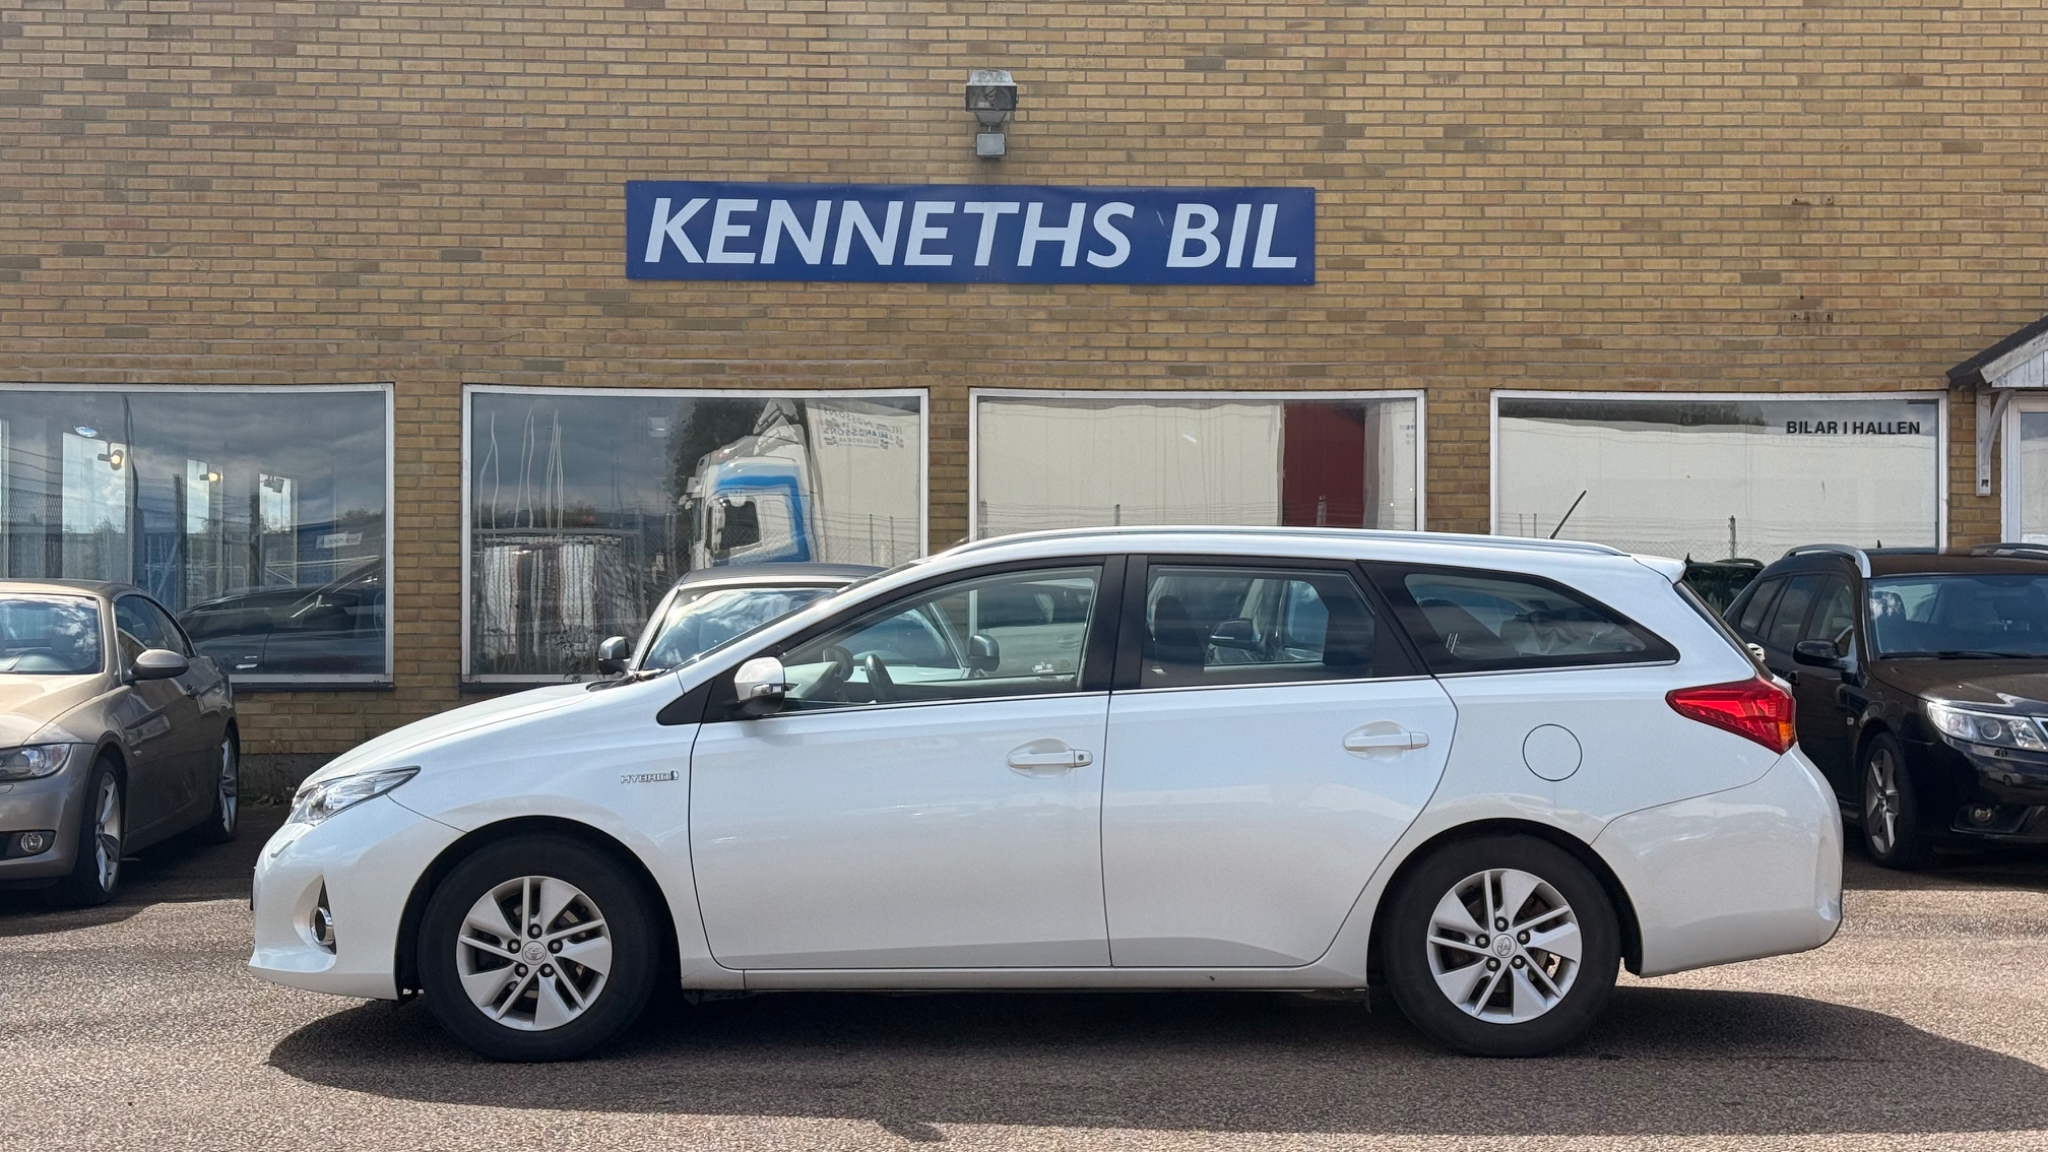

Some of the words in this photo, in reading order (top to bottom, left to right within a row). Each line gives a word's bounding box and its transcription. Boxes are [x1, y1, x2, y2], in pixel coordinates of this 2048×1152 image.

[644, 197, 1135, 268] KENNETHS
[1166, 203, 1297, 268] BIL
[1786, 420, 1838, 434] BILAR
[1843, 421, 1848, 434] I
[1852, 421, 1920, 435] HALLEN
[620, 772, 670, 784] HYBRID
